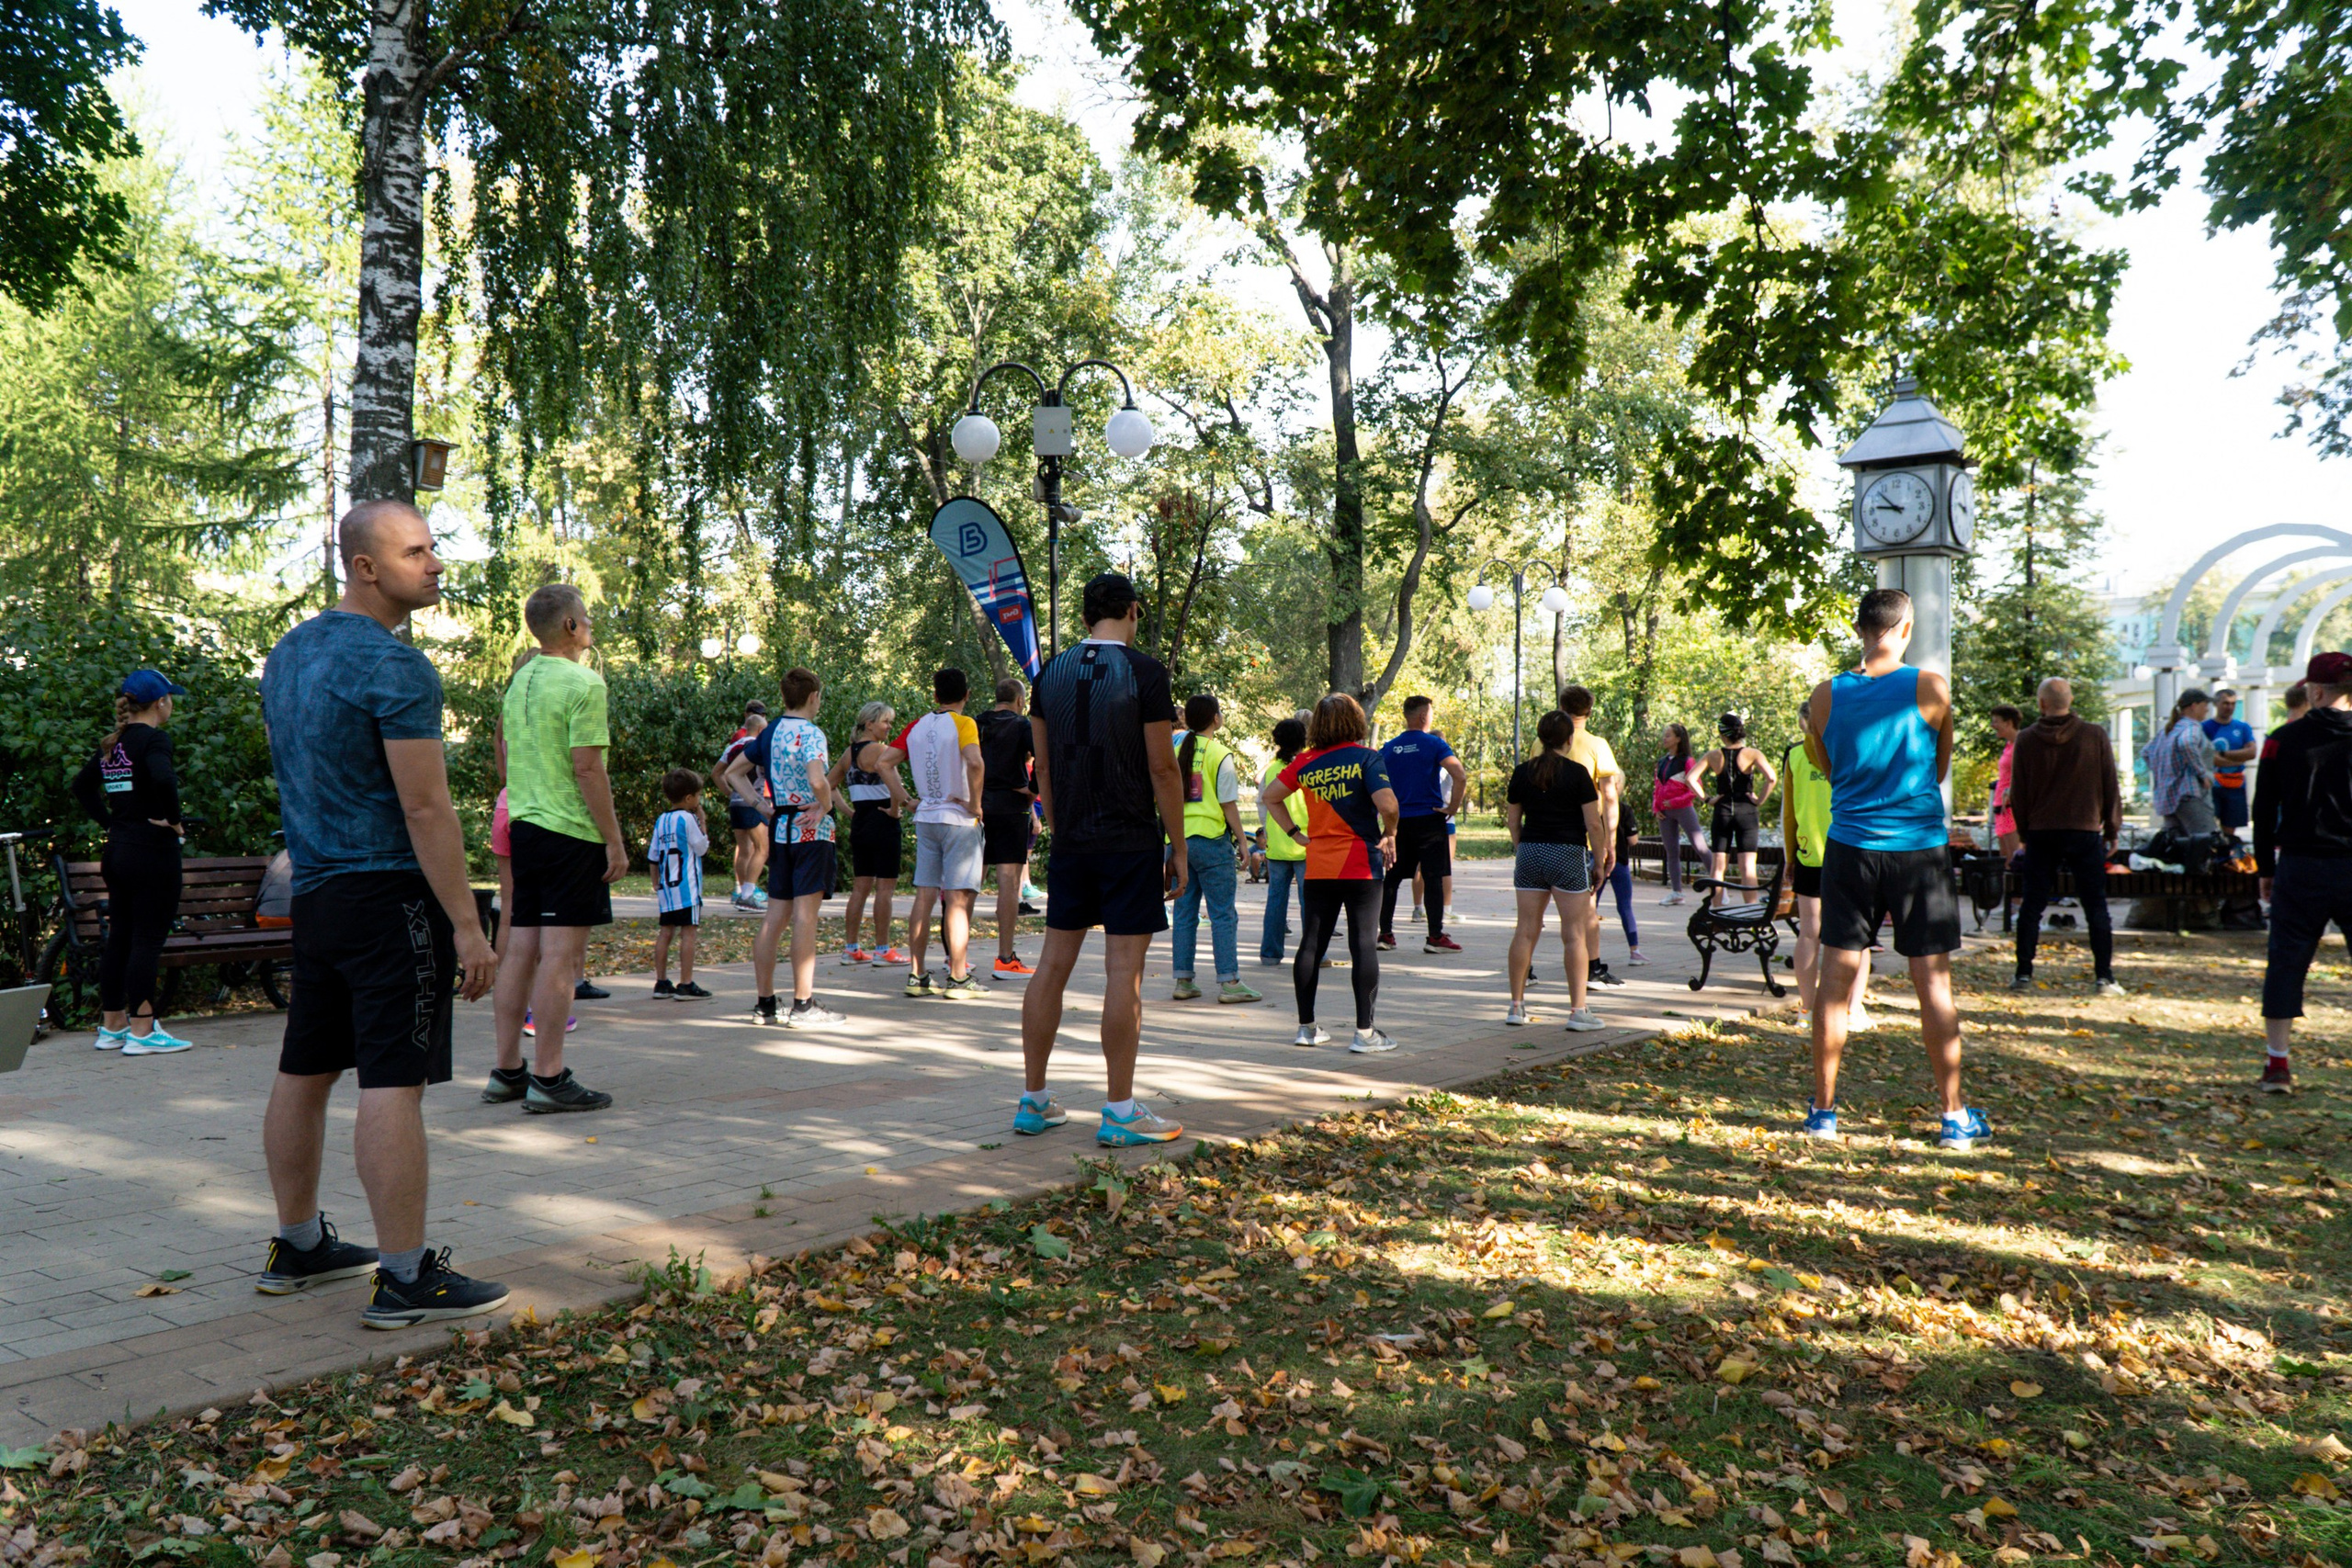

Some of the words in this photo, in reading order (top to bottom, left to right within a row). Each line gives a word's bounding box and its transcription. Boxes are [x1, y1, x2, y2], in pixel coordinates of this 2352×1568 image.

[1892, 479, 1901, 489] 12
[1915, 489, 1921, 499] 2
[1918, 502, 1925, 511] 3
[1298, 762, 1363, 788] UGRESHA
[1311, 783, 1353, 804] TRAIL
[402, 899, 436, 1052] ATHLEX
